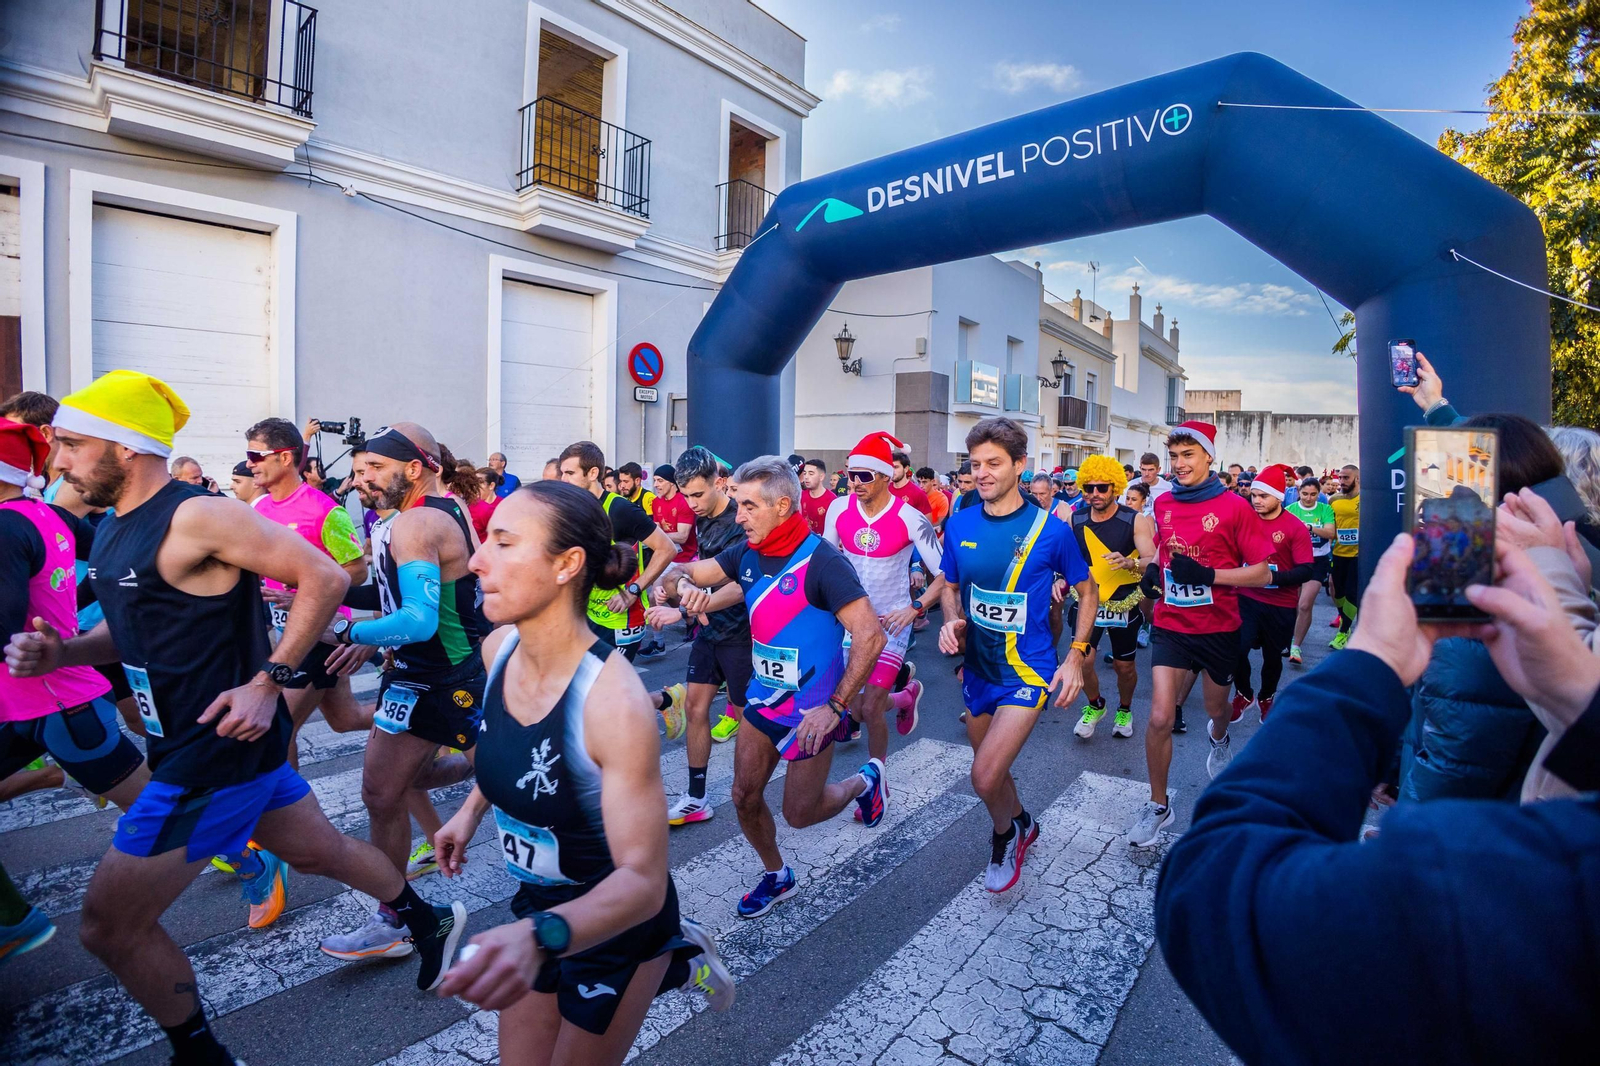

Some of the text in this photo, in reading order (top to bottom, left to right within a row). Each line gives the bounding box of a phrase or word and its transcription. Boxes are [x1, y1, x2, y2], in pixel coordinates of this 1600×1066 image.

[866, 103, 1193, 213] DESNIVEL POSITIVO
[1171, 583, 1204, 597] 415
[976, 603, 1018, 623] 427
[1097, 610, 1123, 620] 401
[761, 660, 784, 679] 12
[503, 833, 536, 870] 47
